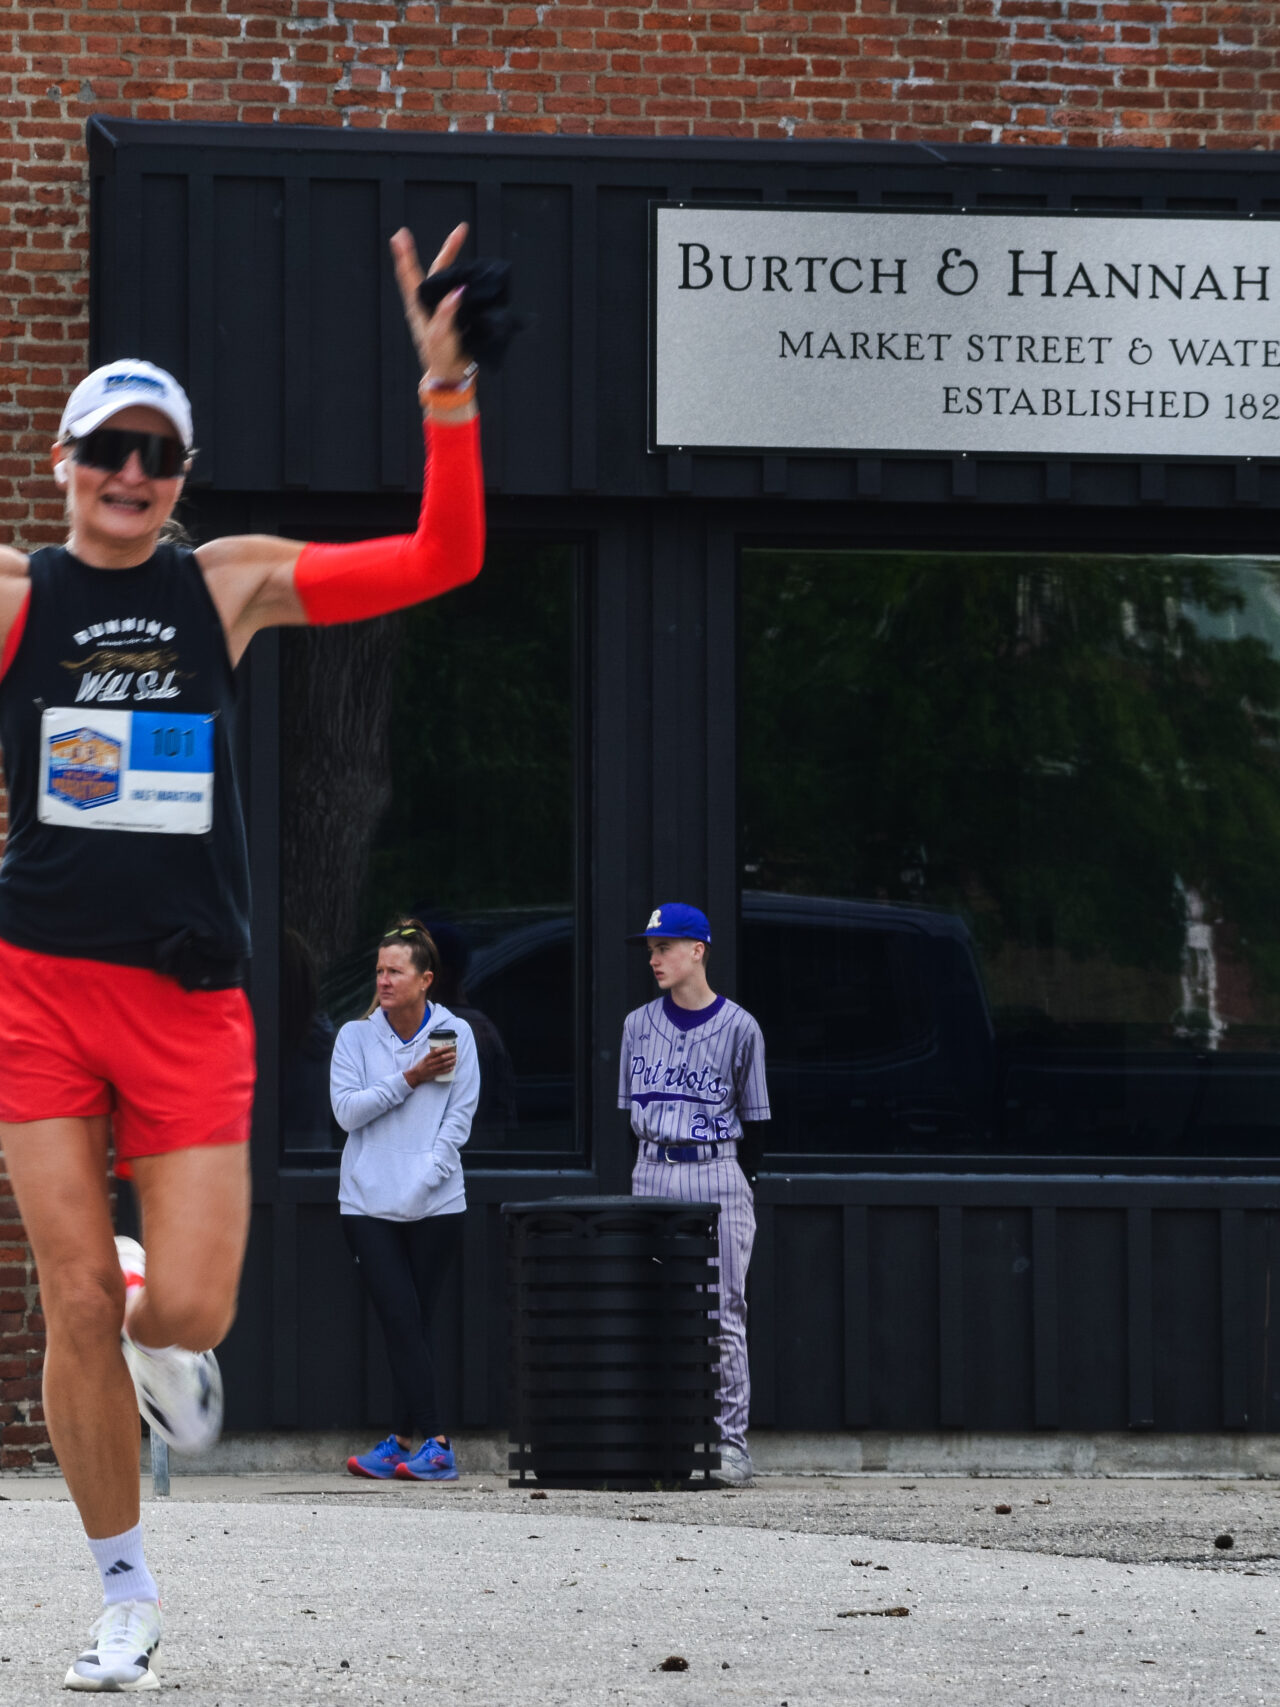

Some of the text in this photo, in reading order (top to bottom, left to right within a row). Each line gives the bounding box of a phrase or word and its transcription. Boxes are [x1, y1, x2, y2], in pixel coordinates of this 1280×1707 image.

[936, 247, 979, 297] &
[778, 330, 952, 362] MARKET
[967, 333, 1113, 365] STREET
[1128, 337, 1153, 365] &
[942, 386, 1209, 419] ESTABLISHED
[73, 617, 177, 646] RUNNING
[74, 668, 136, 703] Wild
[152, 728, 195, 758] 101
[631, 1055, 724, 1095] Patriots
